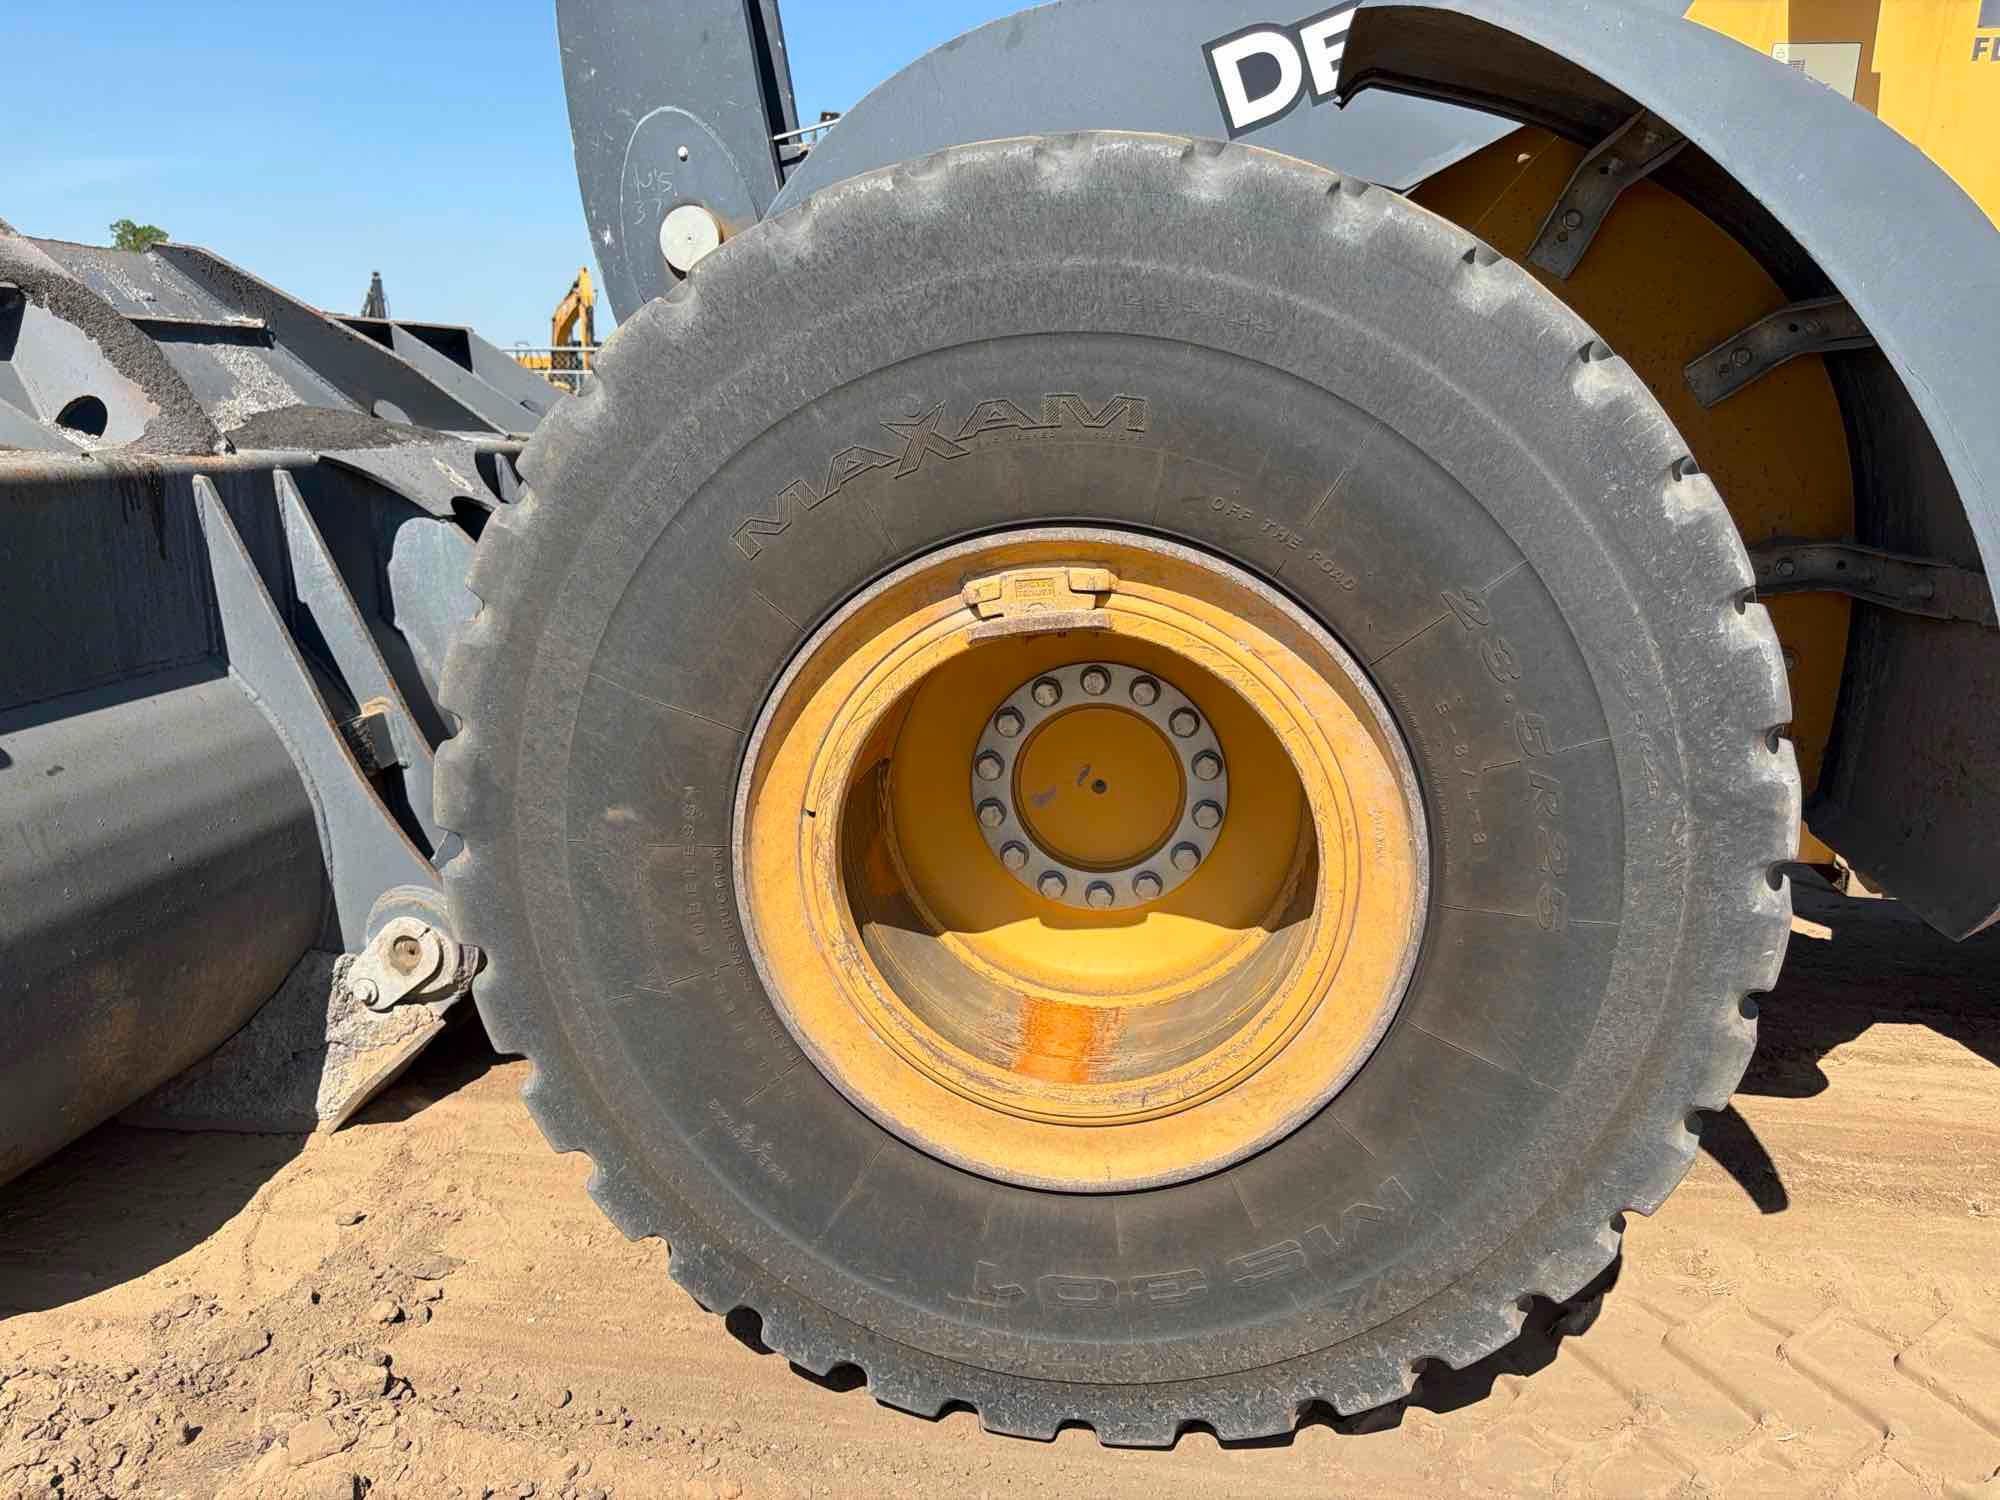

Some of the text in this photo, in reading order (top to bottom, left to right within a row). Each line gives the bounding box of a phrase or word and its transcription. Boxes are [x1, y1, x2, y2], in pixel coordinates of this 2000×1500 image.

[730, 391, 1146, 561] MAXAM
[1209, 495, 1254, 522] OFF
[1260, 518, 1304, 551] THE
